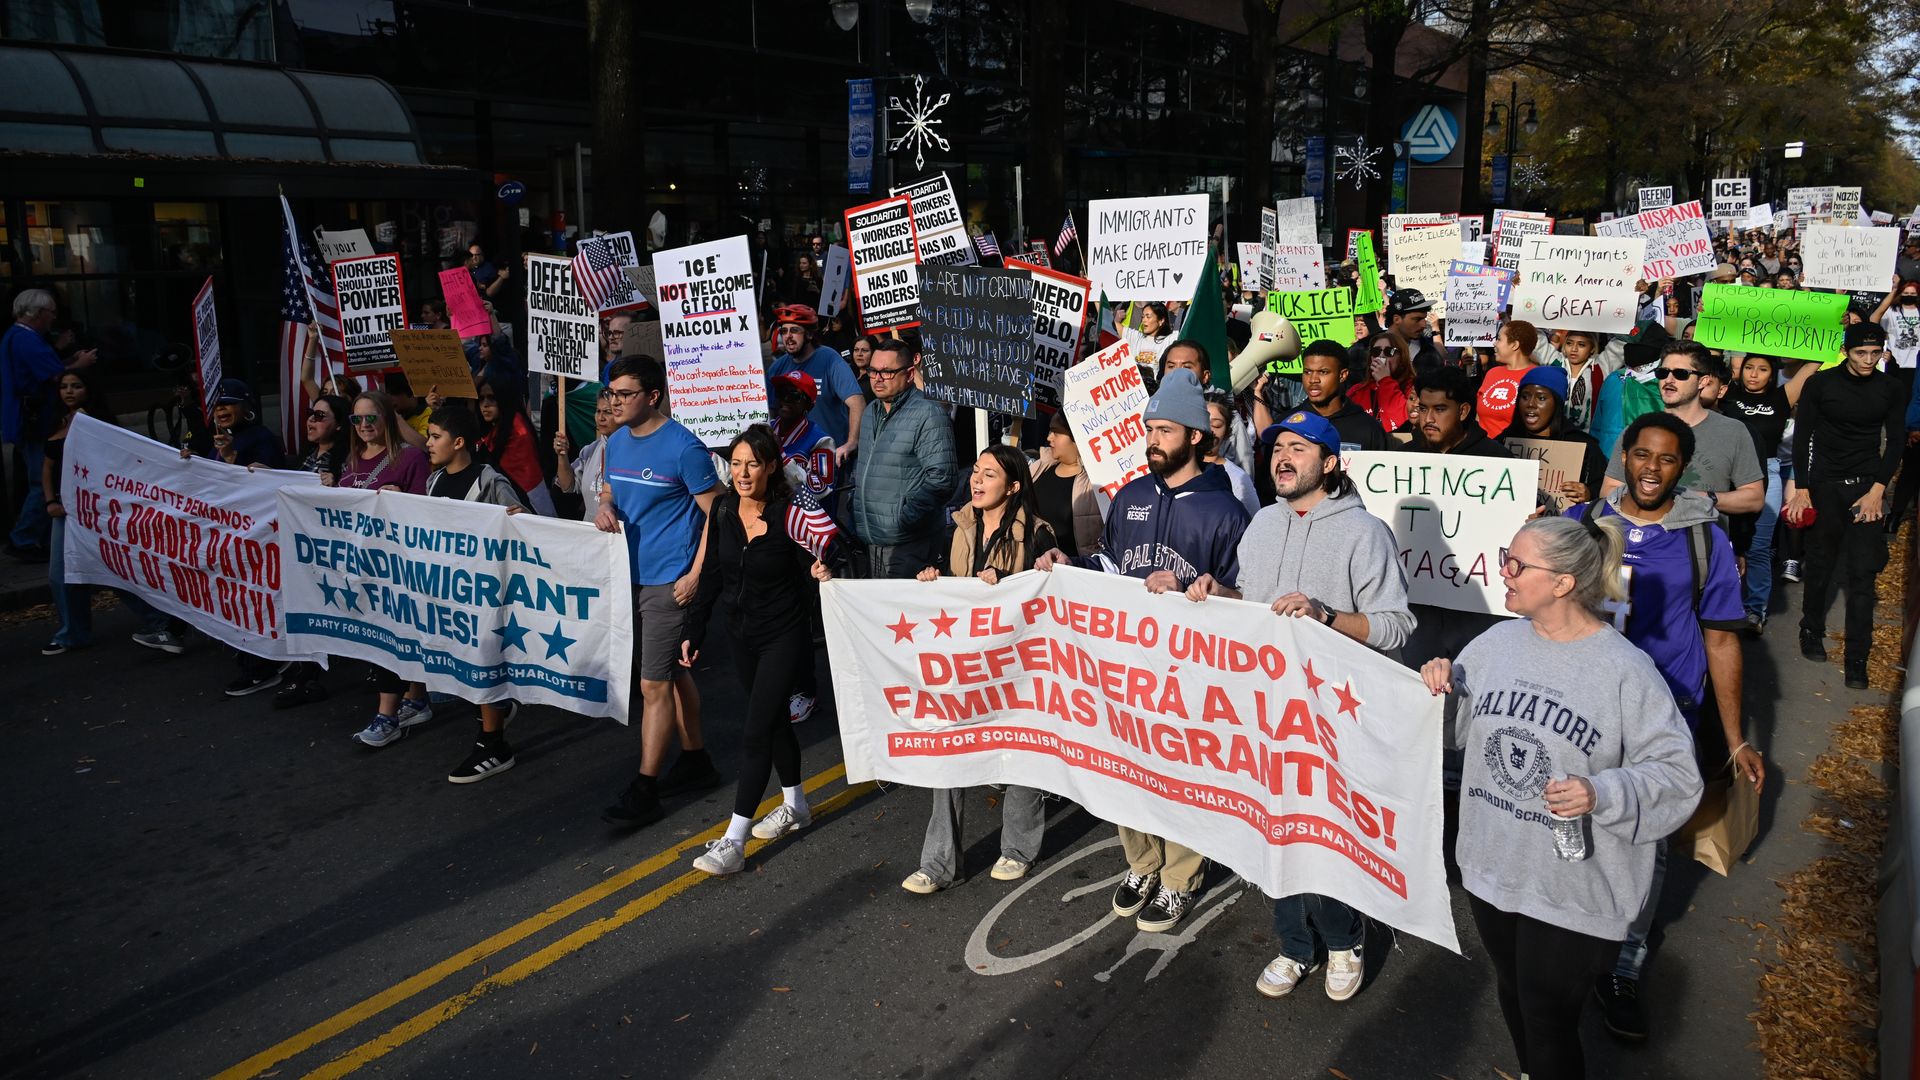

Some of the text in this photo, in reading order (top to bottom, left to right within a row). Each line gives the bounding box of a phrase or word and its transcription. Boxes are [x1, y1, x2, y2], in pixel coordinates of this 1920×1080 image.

[1640, 188, 1671, 201] DEFEND
[1715, 182, 1747, 197] ICE:
[1714, 202, 1747, 210] OUT OF
[1714, 209, 1747, 217] CHARLOTTE!
[856, 208, 902, 228] SOLIDARITY!
[1100, 207, 1196, 235] IMMIGRANTS
[1503, 220, 1550, 233] THE PEOPLE
[1597, 225, 1613, 237] TO
[1616, 218, 1638, 234] THE
[1677, 219, 1703, 234] DOES
[861, 222, 911, 245] WORKERS'
[1394, 231, 1423, 246] LEGAL?
[1668, 230, 1688, 244] THE
[1814, 230, 1853, 249] Soy la
[334, 241, 356, 256] your
[854, 238, 915, 265] STRUGGLE
[919, 236, 957, 256] HAS NO
[1093, 240, 1205, 265] MAKE CHARLOTTE
[1525, 240, 1628, 267] Immigrants
[1669, 239, 1710, 257] YOUR
[1817, 249, 1829, 260] de
[335, 259, 396, 280] WORKERS
[1678, 253, 1715, 271] CHASED?
[337, 275, 399, 292] SHOULD HAVE
[659, 273, 753, 302] NOT WELCOME
[868, 270, 908, 291] HAS NO
[936, 271, 987, 298] ARE NOT
[1115, 268, 1170, 289] GREAT
[1575, 274, 1623, 288] America
[340, 287, 400, 312] POWER
[681, 292, 736, 314] GTFOH!
[862, 284, 919, 310] BORDERS!
[1269, 288, 1352, 318] FUCK ICE!
[1542, 294, 1608, 320] GREAT
[1049, 305, 1061, 318] EL
[1712, 297, 1811, 325] Duro Que
[343, 312, 404, 335] NOT THE
[531, 316, 595, 342] IT'S TIME FOR
[665, 317, 732, 339] MALCOLM
[739, 315, 749, 331] X
[345, 331, 391, 347] BILLIONAIR
[537, 335, 589, 359] A GENERAL
[1742, 319, 1840, 352] PRESIDENTE
[544, 352, 582, 375] STRIKE!
[923, 353, 937, 366] ICE
[1069, 366, 1100, 383] Parents
[1090, 365, 1141, 407] FUTURE
[716, 384, 725, 392] no
[1490, 387, 1510, 401] PSL
[683, 416, 698, 425] man
[700, 413, 713, 423] who
[715, 412, 735, 422] stands
[738, 409, 748, 420] for
[1064, 400, 1080, 417] For
[1082, 390, 1149, 435] NOW I WILL
[1117, 454, 1135, 473] For
[105, 473, 183, 510] CHARLOTTE
[1365, 463, 1516, 505] CHINGA
[1127, 511, 1150, 522] RESIST
[1400, 505, 1462, 539] TU
[76, 486, 281, 591] ICE & BORDER PATRO
[315, 507, 551, 570] THE PEOPLE UNITED WILL
[294, 532, 600, 620] DEFEND IMMIGRANT
[99, 537, 278, 639] OUT OF OUR CITY!
[361, 583, 479, 648] FAMLIES!
[308, 618, 398, 646] PARTY FOR SOCIALISM
[969, 595, 1286, 681] EL PUEBLO UNIDO
[918, 637, 1339, 763] DEFENDERÁ A LAS
[1472, 691, 1603, 758] SALVATORE
[883, 676, 1397, 852] FAMILIAS MIGRANTES!
[894, 736, 936, 749] PARTY
[942, 732, 976, 748] FOR
[981, 730, 1059, 750] SOCIALISM
[1059, 745, 1085, 761] AND
[1090, 754, 1167, 793] LIBERATION
[1271, 820, 1401, 890] @PSLNATIONAL
